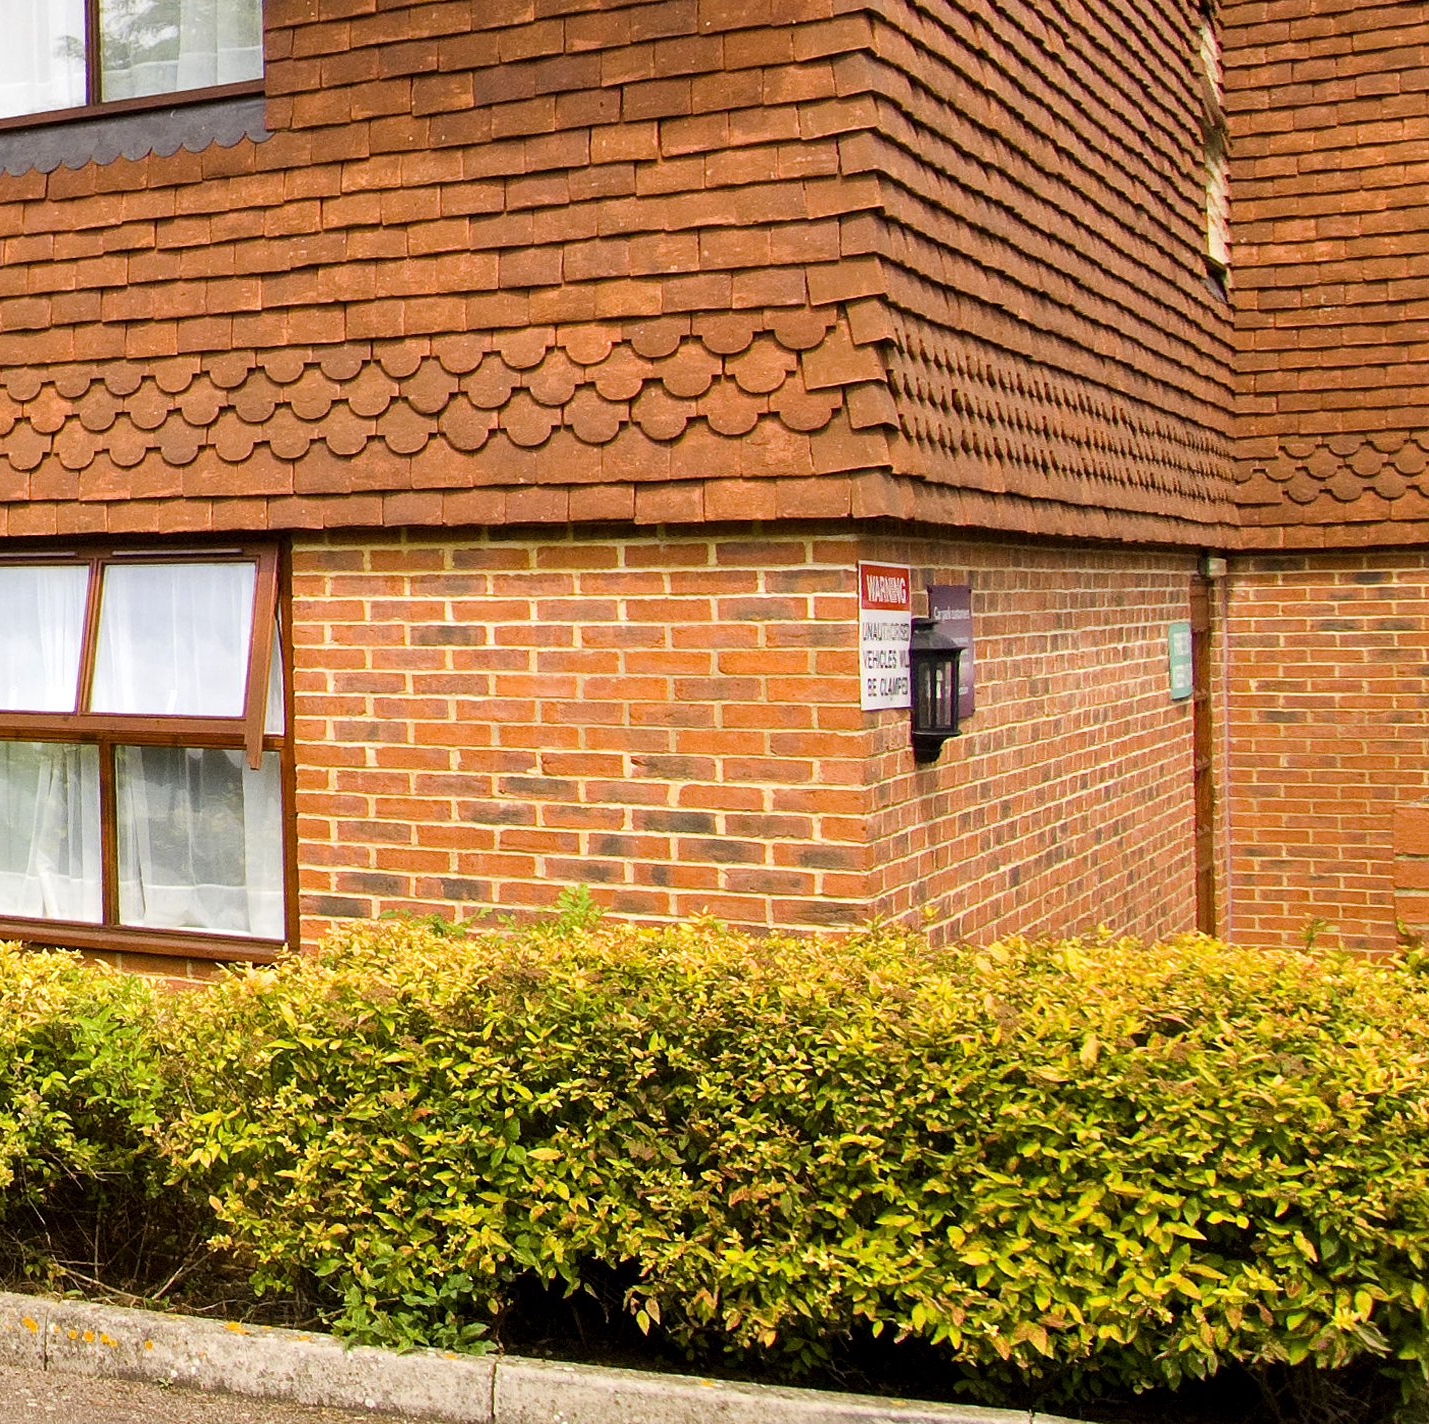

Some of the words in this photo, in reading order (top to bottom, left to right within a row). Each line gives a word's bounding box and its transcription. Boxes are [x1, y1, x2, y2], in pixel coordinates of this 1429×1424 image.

[866, 574, 907, 604] WARNING
[862, 649, 897, 669] VEHICLES
[867, 677, 878, 697] BE
